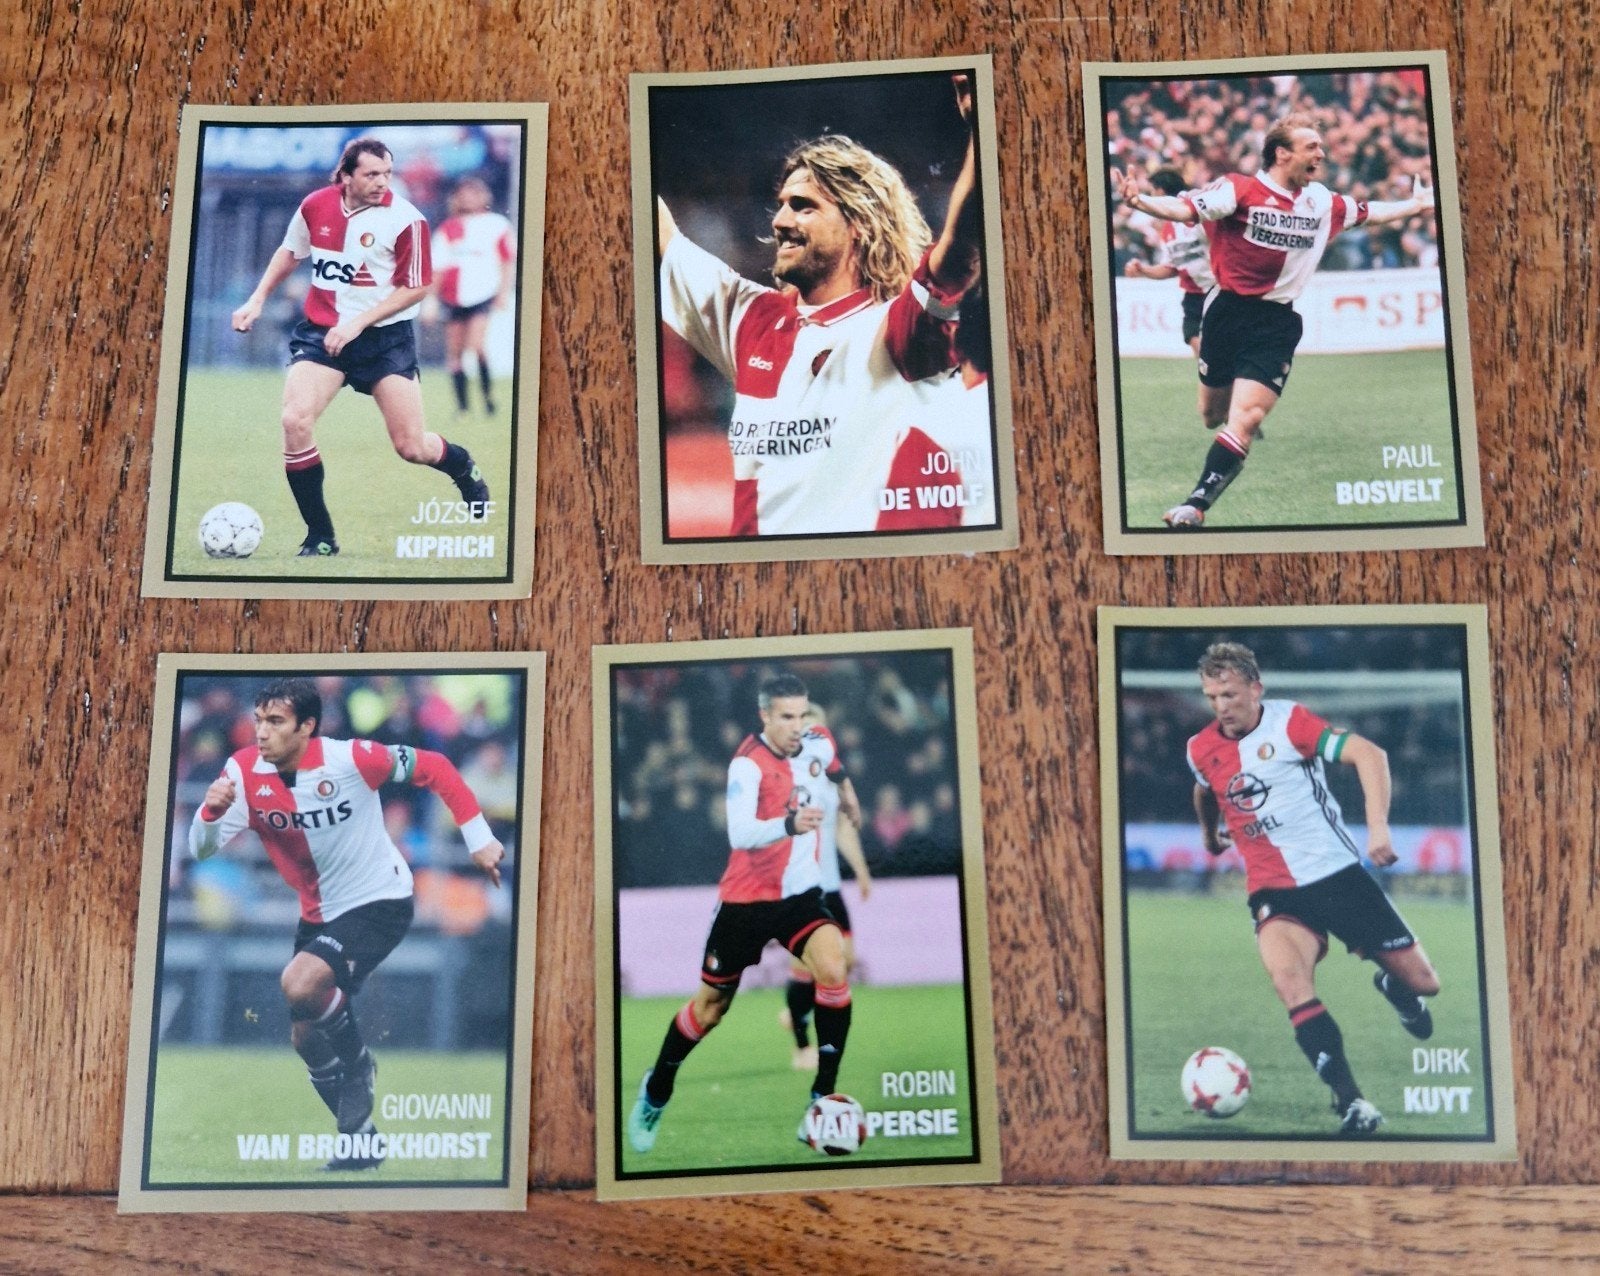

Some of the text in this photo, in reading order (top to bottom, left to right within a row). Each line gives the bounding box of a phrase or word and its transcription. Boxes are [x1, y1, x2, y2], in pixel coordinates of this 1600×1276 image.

[1252, 211, 1278, 227] STAD
[920, 449, 980, 476] JOHN
[1382, 444, 1442, 469] PAUL
[879, 483, 985, 511] DE WOLF
[1335, 477, 1444, 505] BOSVELT
[411, 496, 497, 525] JÓZSEF
[396, 535, 495, 559] KIPRICH
[1243, 814, 1284, 837] OPEL
[1412, 1048, 1471, 1075] DIRK
[881, 1070, 956, 1098] ROBIN
[381, 1093, 492, 1121] GIOVANNI
[1403, 1086, 1473, 1114] KUYT
[807, 1108, 959, 1142] VAN PERSIE
[236, 1132, 492, 1161] VAN BRONCKHORST
